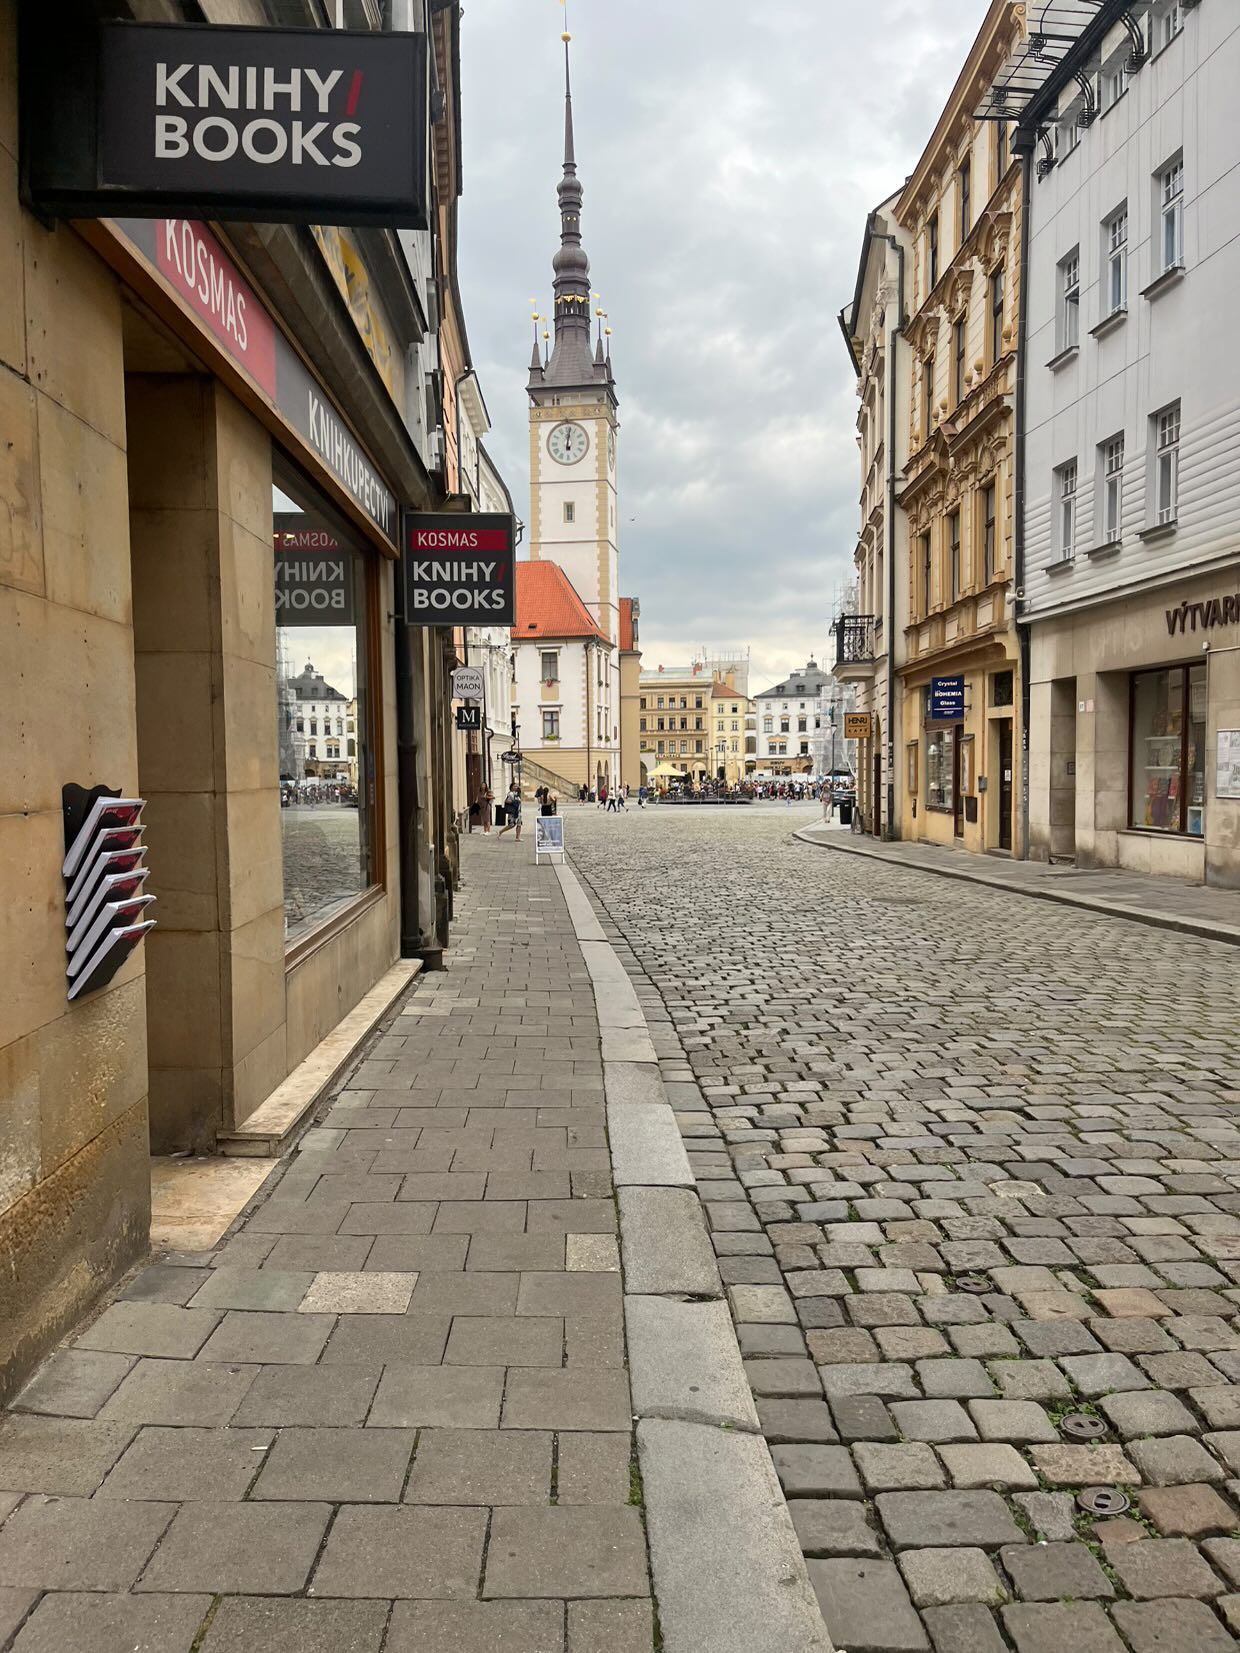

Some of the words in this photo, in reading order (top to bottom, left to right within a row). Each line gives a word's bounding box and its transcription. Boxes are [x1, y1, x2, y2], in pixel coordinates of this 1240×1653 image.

[154, 114, 362, 168] BOOKS
[164, 218, 248, 351] KOSMAS
[308, 389, 390, 534] KNIHKUPECTVÍ
[417, 532, 478, 547] KOSMAS
[413, 588, 506, 610] BOOKS
[462, 710, 475, 722] M
